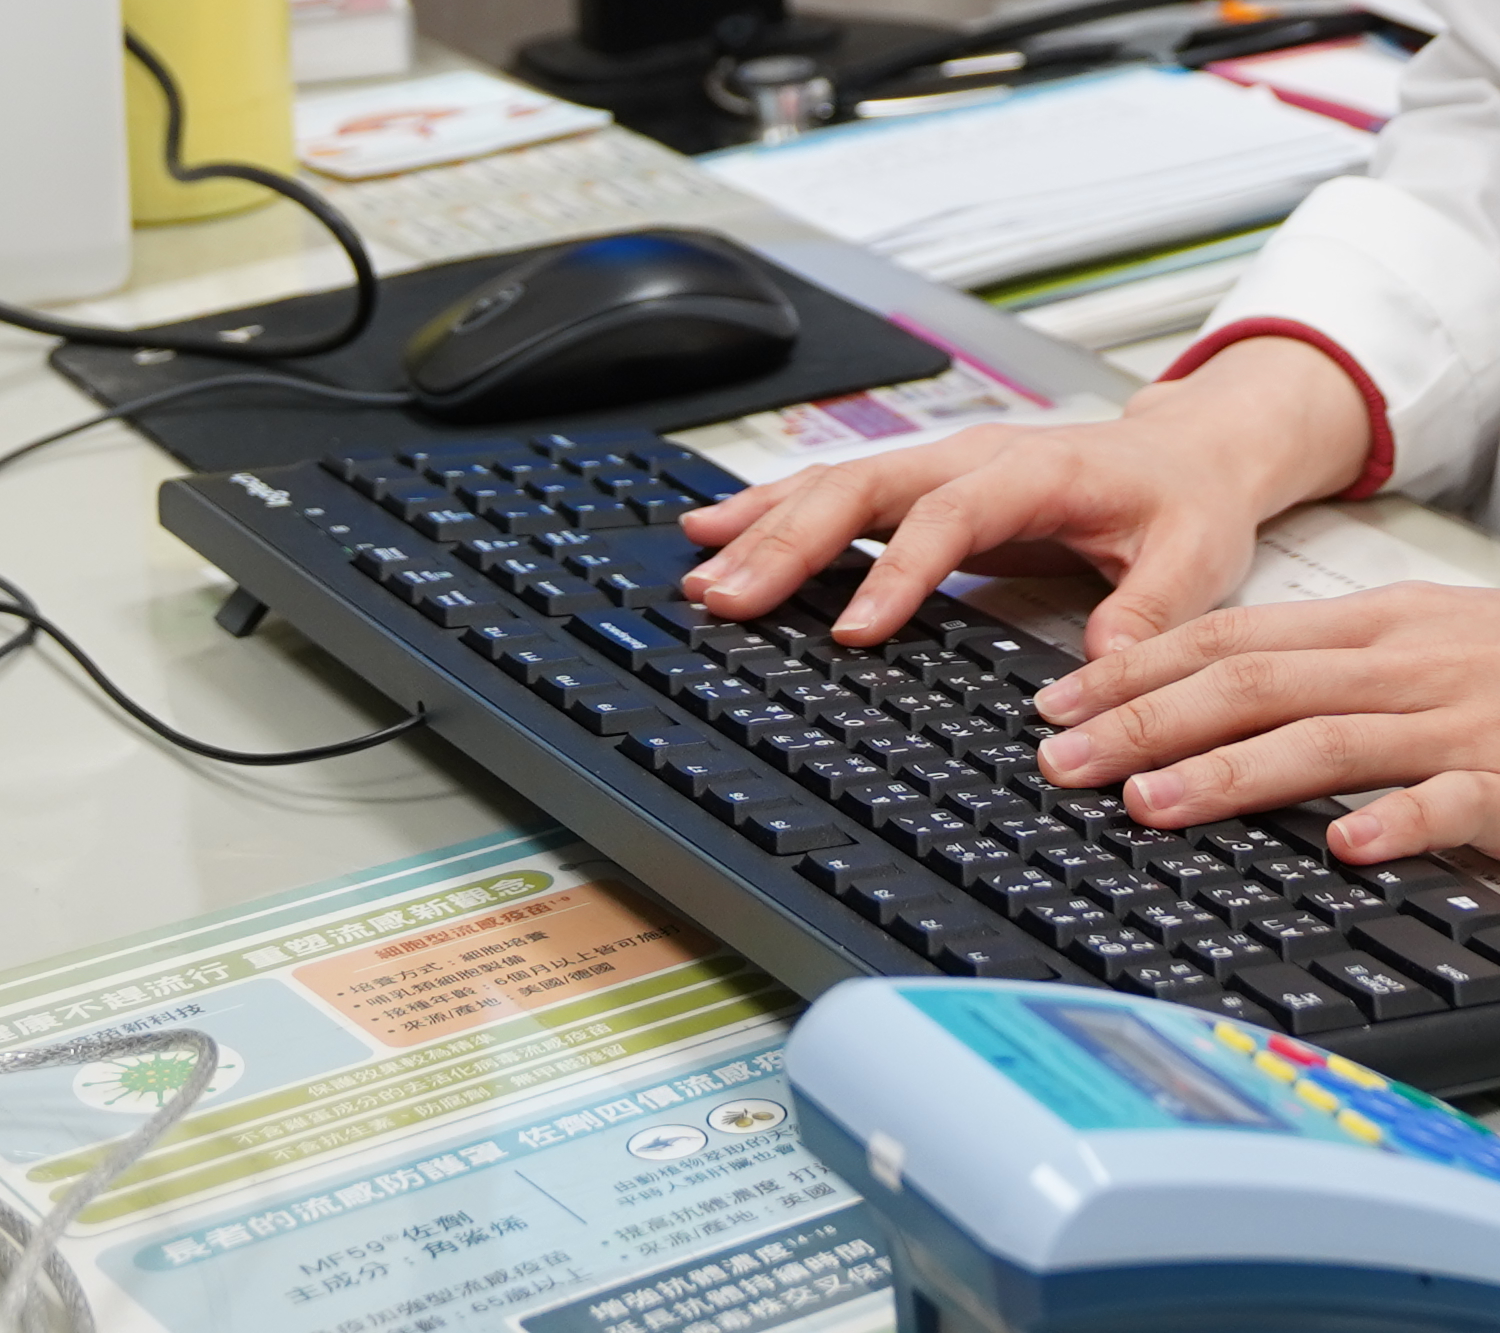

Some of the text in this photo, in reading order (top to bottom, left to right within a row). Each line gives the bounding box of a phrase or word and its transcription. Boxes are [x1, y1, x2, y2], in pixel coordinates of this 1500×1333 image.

[481, 625, 508, 638] F12
[597, 620, 646, 650] Backspace
[517, 650, 542, 662] F11
[553, 674, 580, 687] F10
[593, 702, 617, 712] F9
[646, 736, 669, 746] F8
[685, 763, 709, 774] F7
[724, 791, 750, 801] F6
[766, 819, 793, 830] F5
[825, 858, 851, 869] F4
[869, 887, 896, 898] F3
[242, 877, 536, 970] 重塑流感新觀念
[915, 918, 942, 929] F2
[964, 950, 991, 962] F1
[1435, 962, 1471, 982] Shift
[365, 954, 527, 1008] 哺乳類細胞製備
[161, 1140, 509, 1265] 長者的流感防護罩
